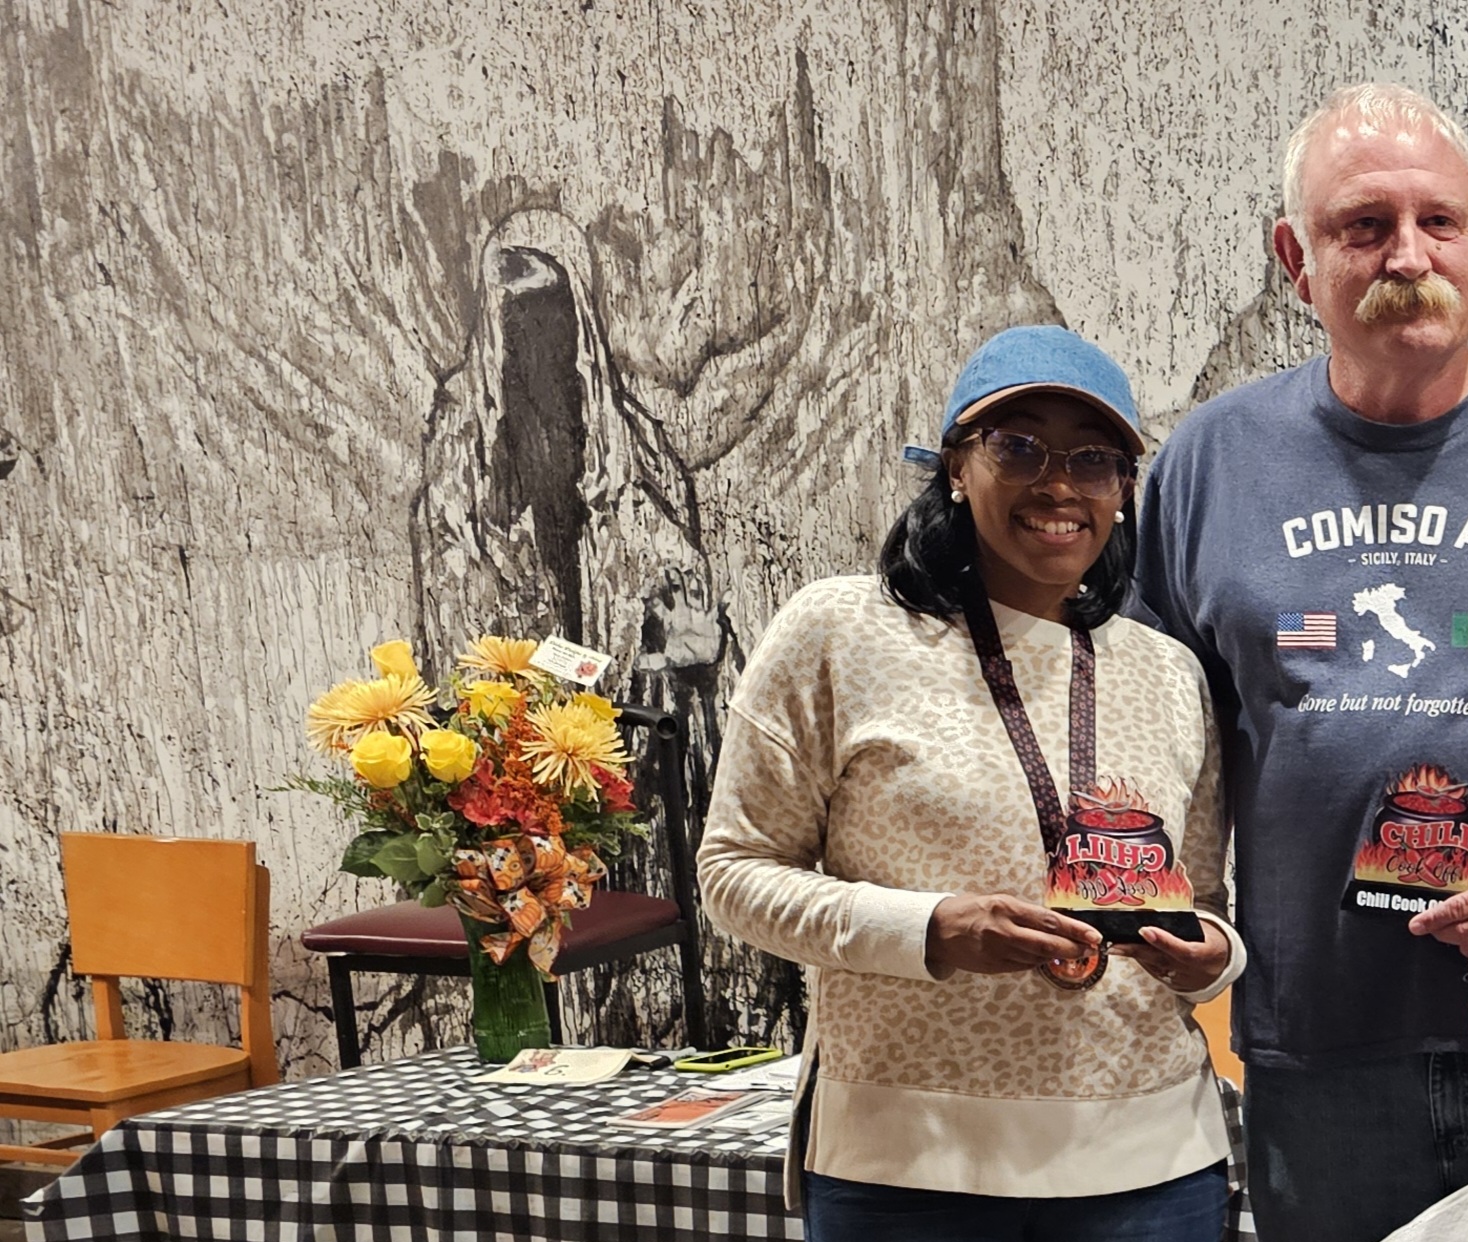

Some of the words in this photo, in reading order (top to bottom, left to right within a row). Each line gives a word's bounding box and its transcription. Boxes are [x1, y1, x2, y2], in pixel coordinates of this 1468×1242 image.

[1281, 503, 1448, 558] COMISO
[1360, 552, 1401, 566] SICILY,
[1404, 552, 1437, 566] ITALY
[1340, 692, 1369, 712] but
[1371, 694, 1402, 712] not
[1386, 855, 1424, 875] Cook
[1433, 861, 1461, 884] Off
[1391, 894, 1427, 913] Cook
